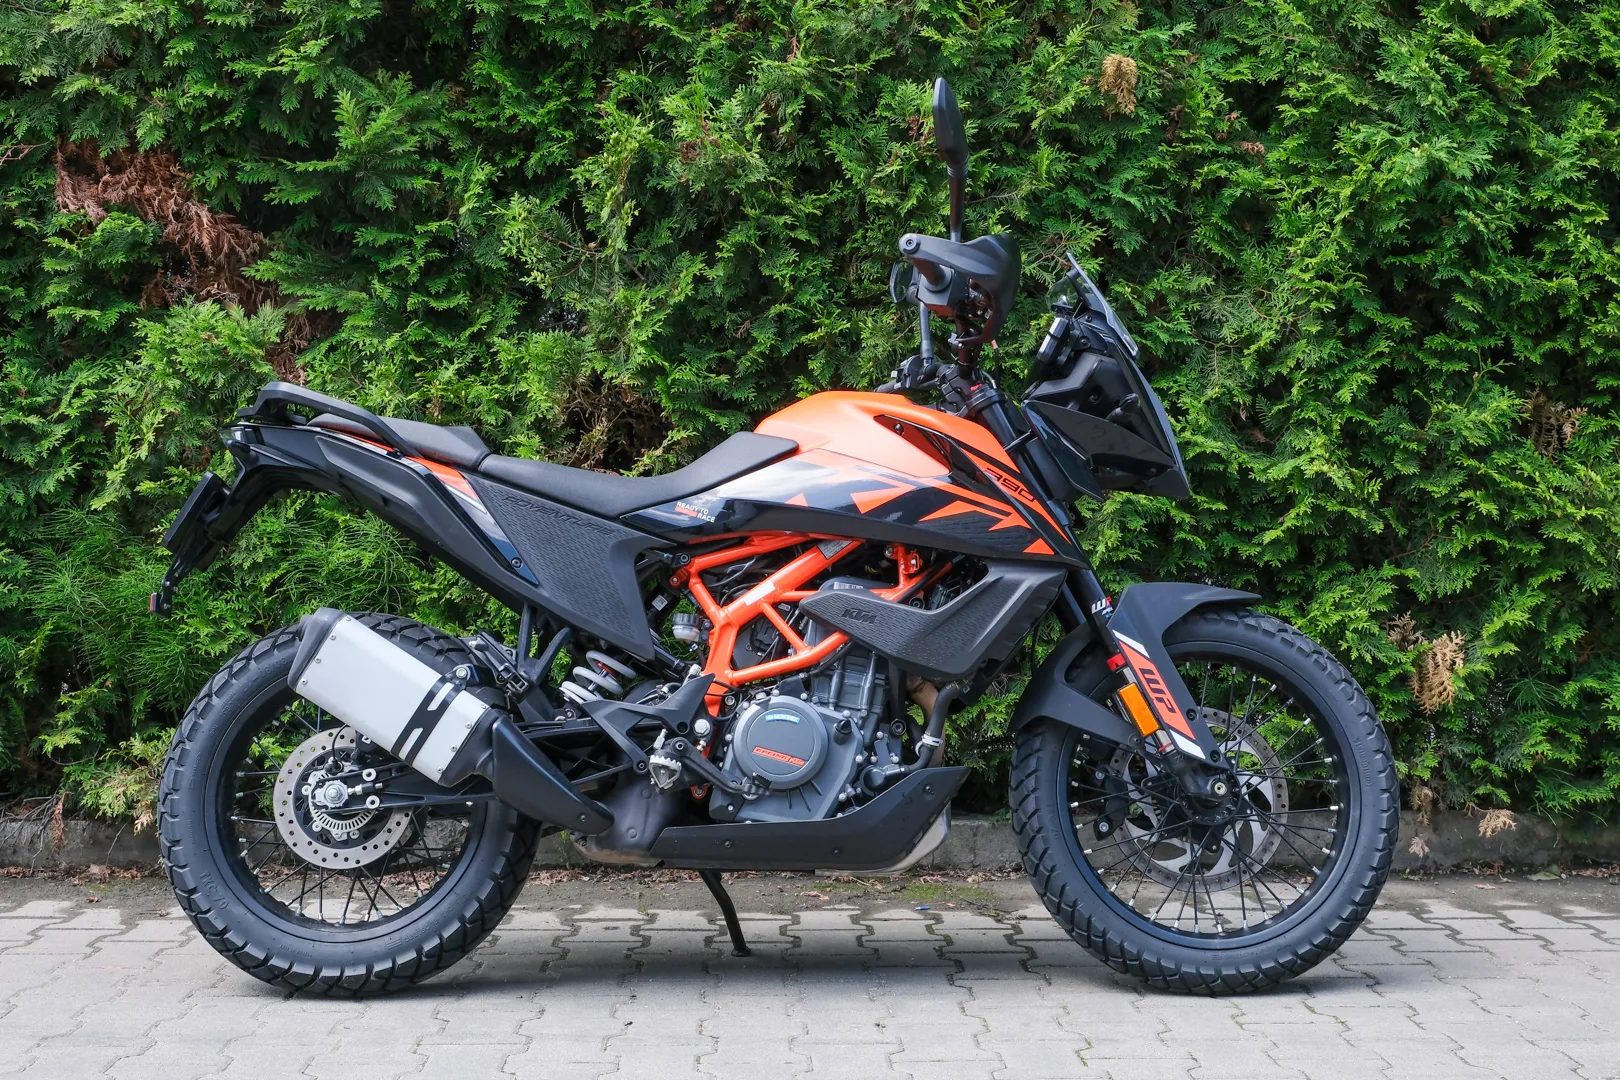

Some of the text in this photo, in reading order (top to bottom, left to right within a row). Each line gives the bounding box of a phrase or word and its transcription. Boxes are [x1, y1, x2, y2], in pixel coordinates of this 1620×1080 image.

[984, 467, 1036, 502] 390
[501, 496, 618, 536] ADVENTURE
[676, 501, 709, 515] READY TO
[697, 512, 716, 523] RACE
[841, 607, 877, 625] KTM
[1138, 667, 1177, 713] WP
